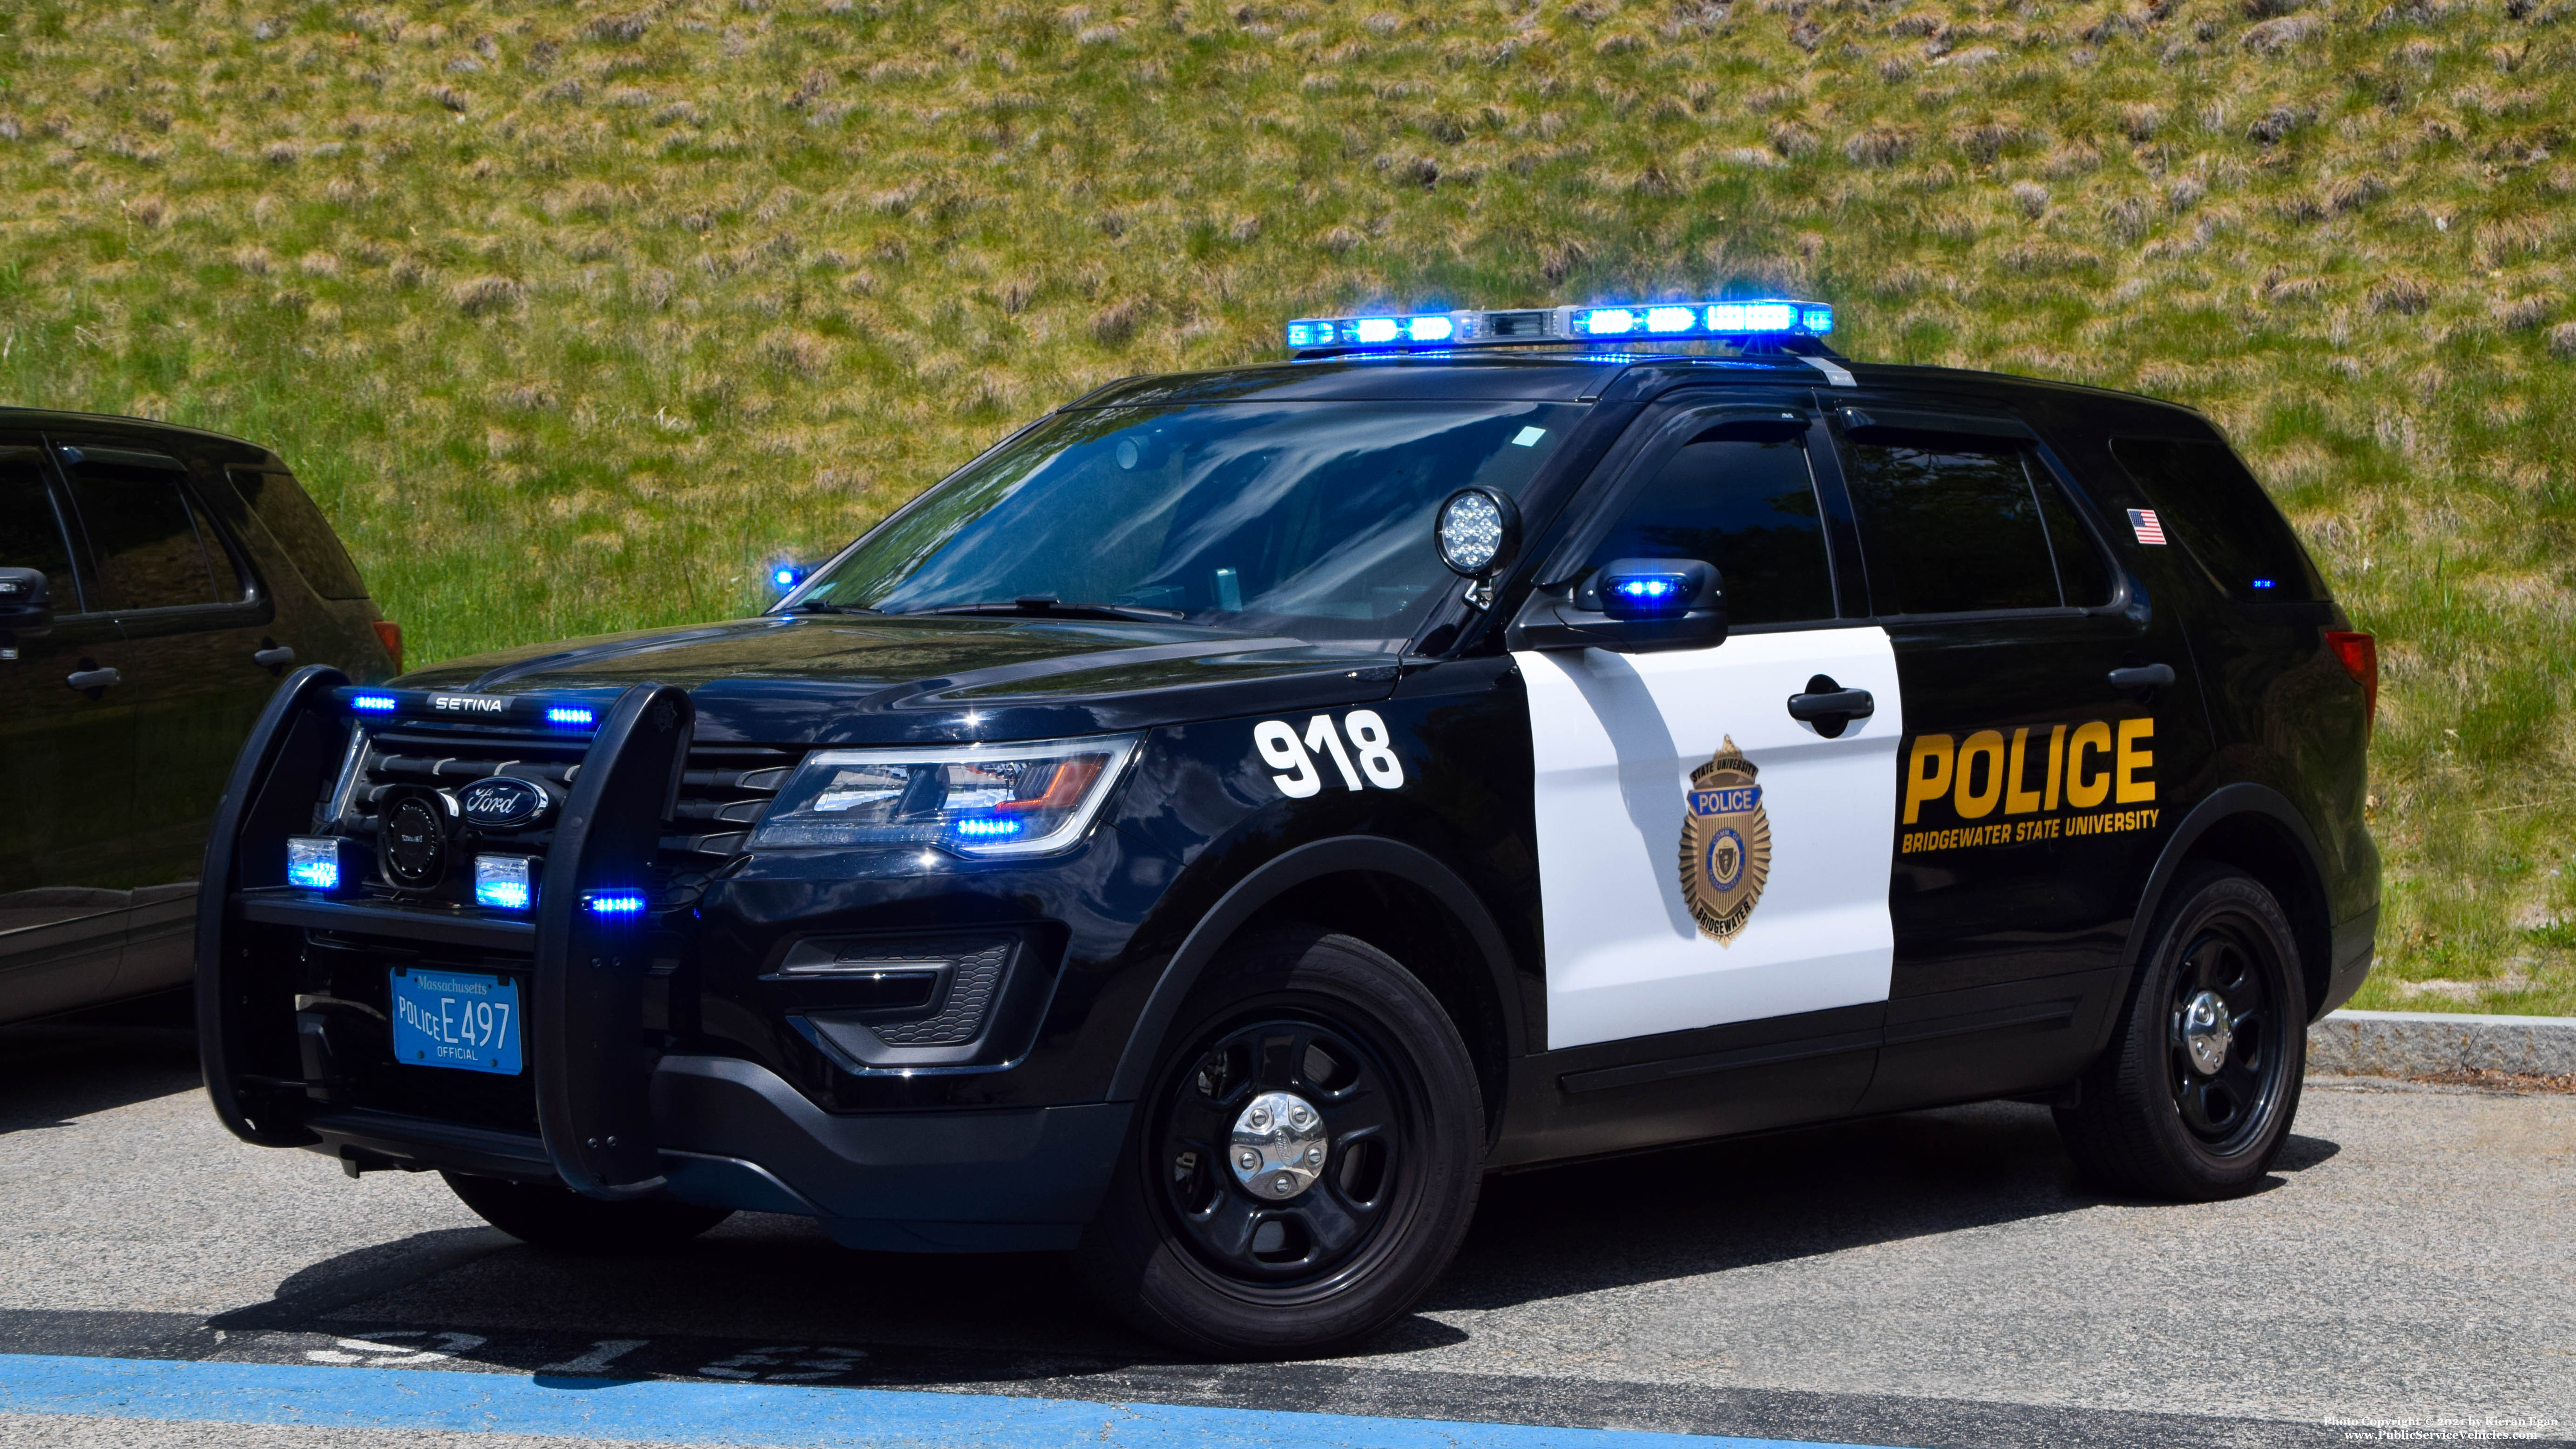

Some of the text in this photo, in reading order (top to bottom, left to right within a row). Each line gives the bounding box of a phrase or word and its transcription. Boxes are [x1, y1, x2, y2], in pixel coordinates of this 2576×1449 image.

[436, 697, 501, 712] SETINA
[1254, 710, 1404, 798] 918
[1692, 758, 1756, 782] STATE UNIVERSITY
[1902, 718, 2156, 825] POLICE
[467, 785, 521, 813] Ford
[1699, 790, 1752, 813] POLICE
[1902, 809, 2160, 853] BRIDGEWATER STATE UNIVERSITY
[1696, 901, 1751, 934] BRIDGEWATER
[418, 975, 487, 995] Massachusetts
[399, 995, 509, 1049] POLICE E497
[437, 1046, 478, 1061] OFFICIAL
